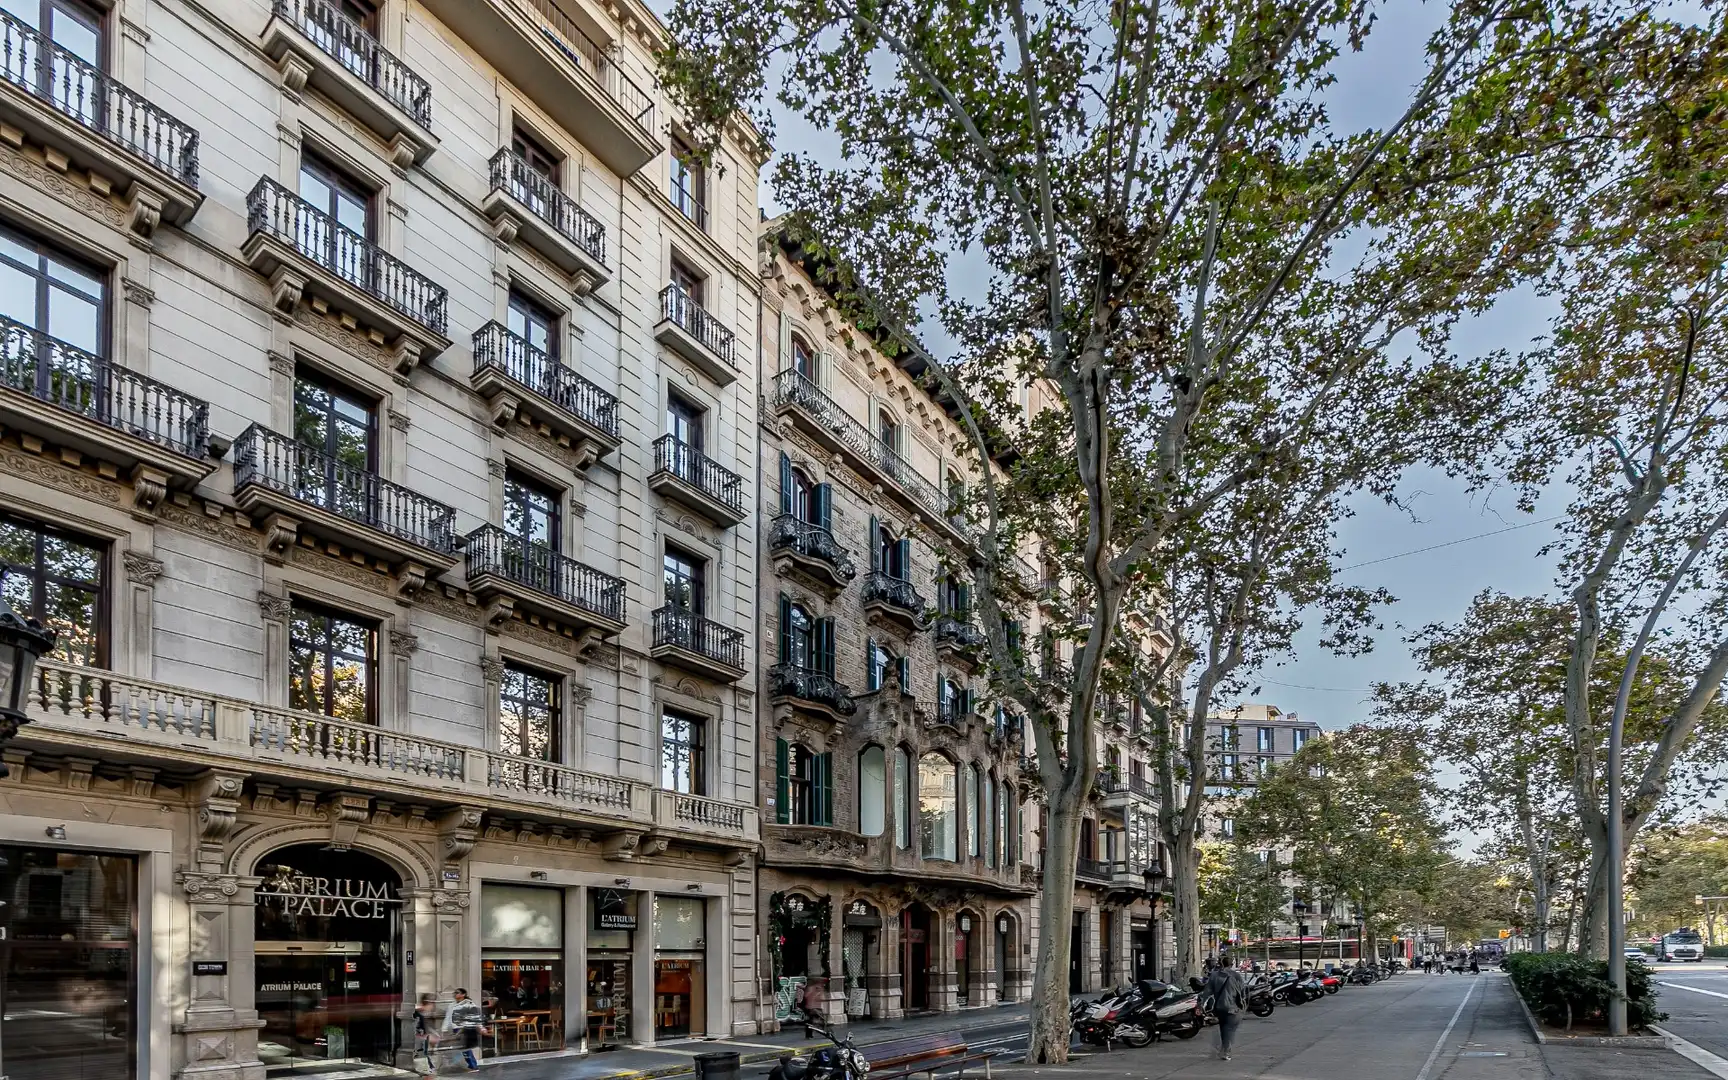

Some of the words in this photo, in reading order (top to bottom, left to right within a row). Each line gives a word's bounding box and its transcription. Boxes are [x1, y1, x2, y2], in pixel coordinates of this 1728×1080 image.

[275, 875, 389, 900] ATRIUM
[282, 896, 385, 919] PALACE
[601, 914, 636, 923] L'ATRIUM
[260, 983, 292, 992] ATRIUM
[293, 982, 322, 991] PALACE
